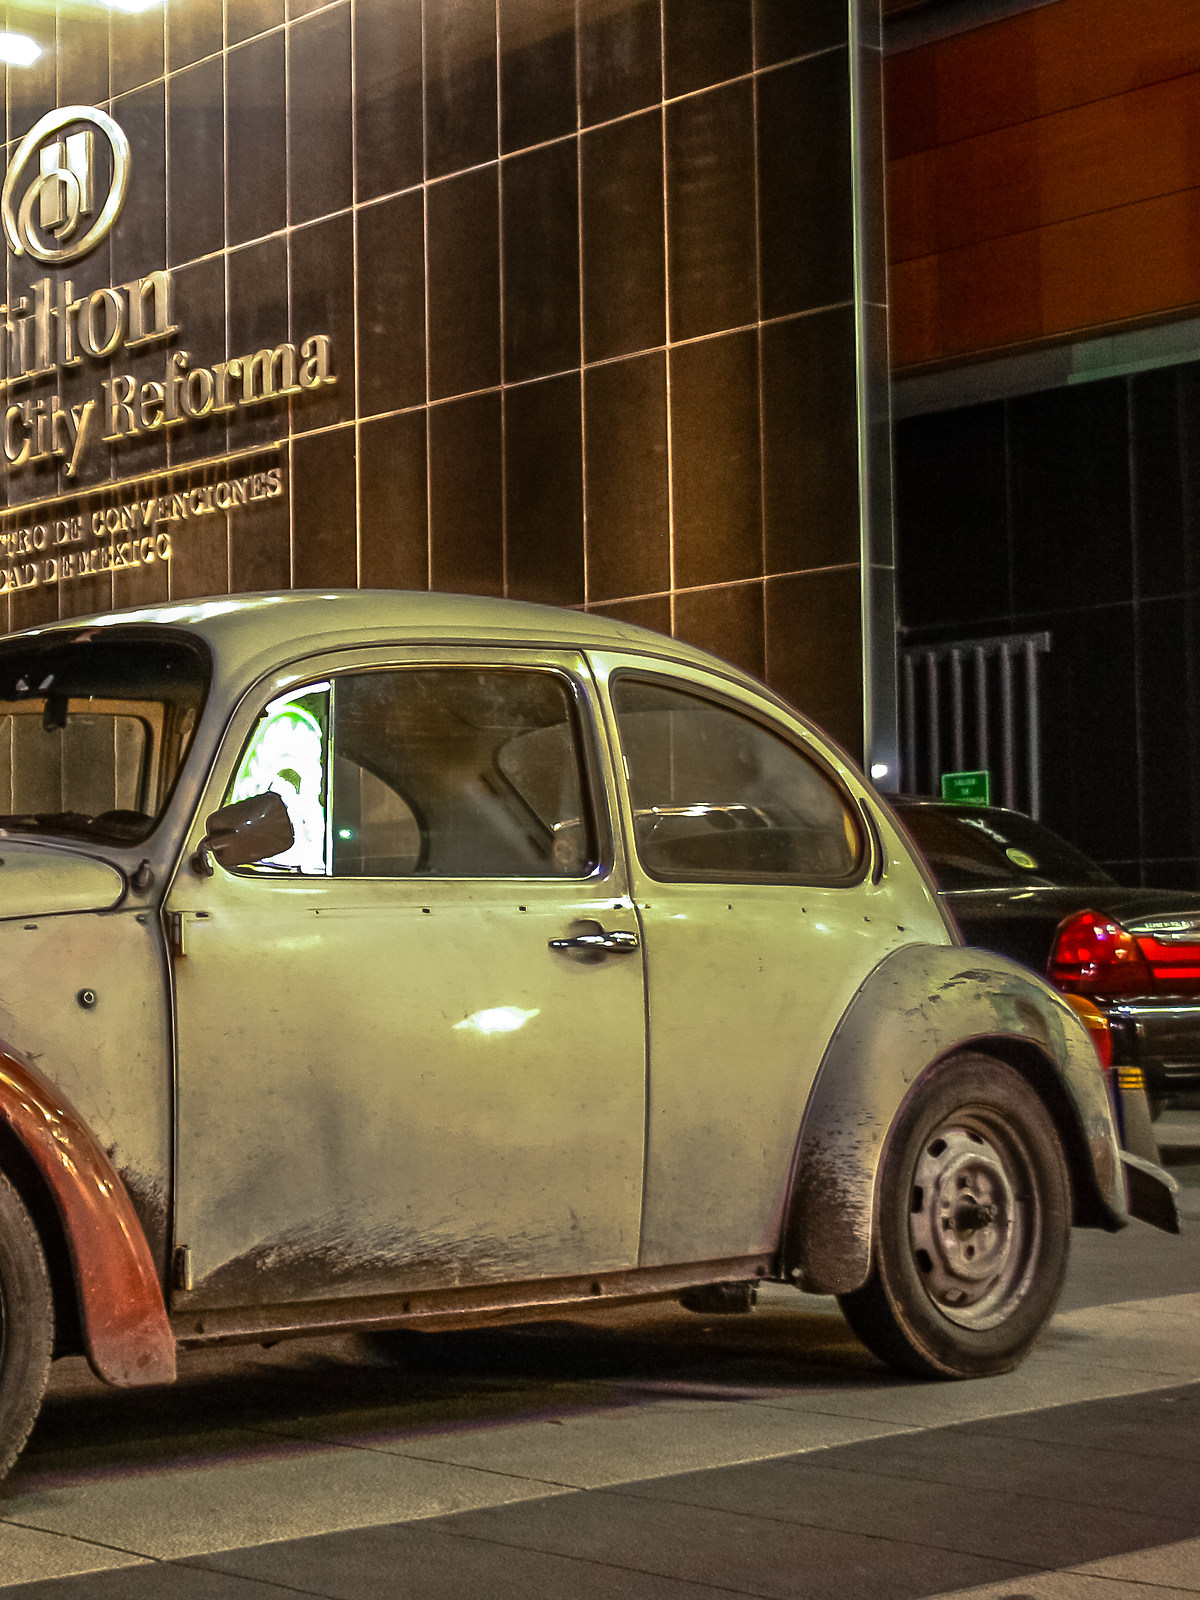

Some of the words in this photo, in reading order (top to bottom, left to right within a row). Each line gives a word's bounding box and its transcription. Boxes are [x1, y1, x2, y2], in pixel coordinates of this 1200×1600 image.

[4, 396, 96, 477] City
[101, 334, 337, 441] Reforma
[52, 515, 84, 545] DE
[91, 467, 282, 536] CONVENCIONES
[42, 553, 74, 584] DE
[78, 532, 173, 576] MEXICO
